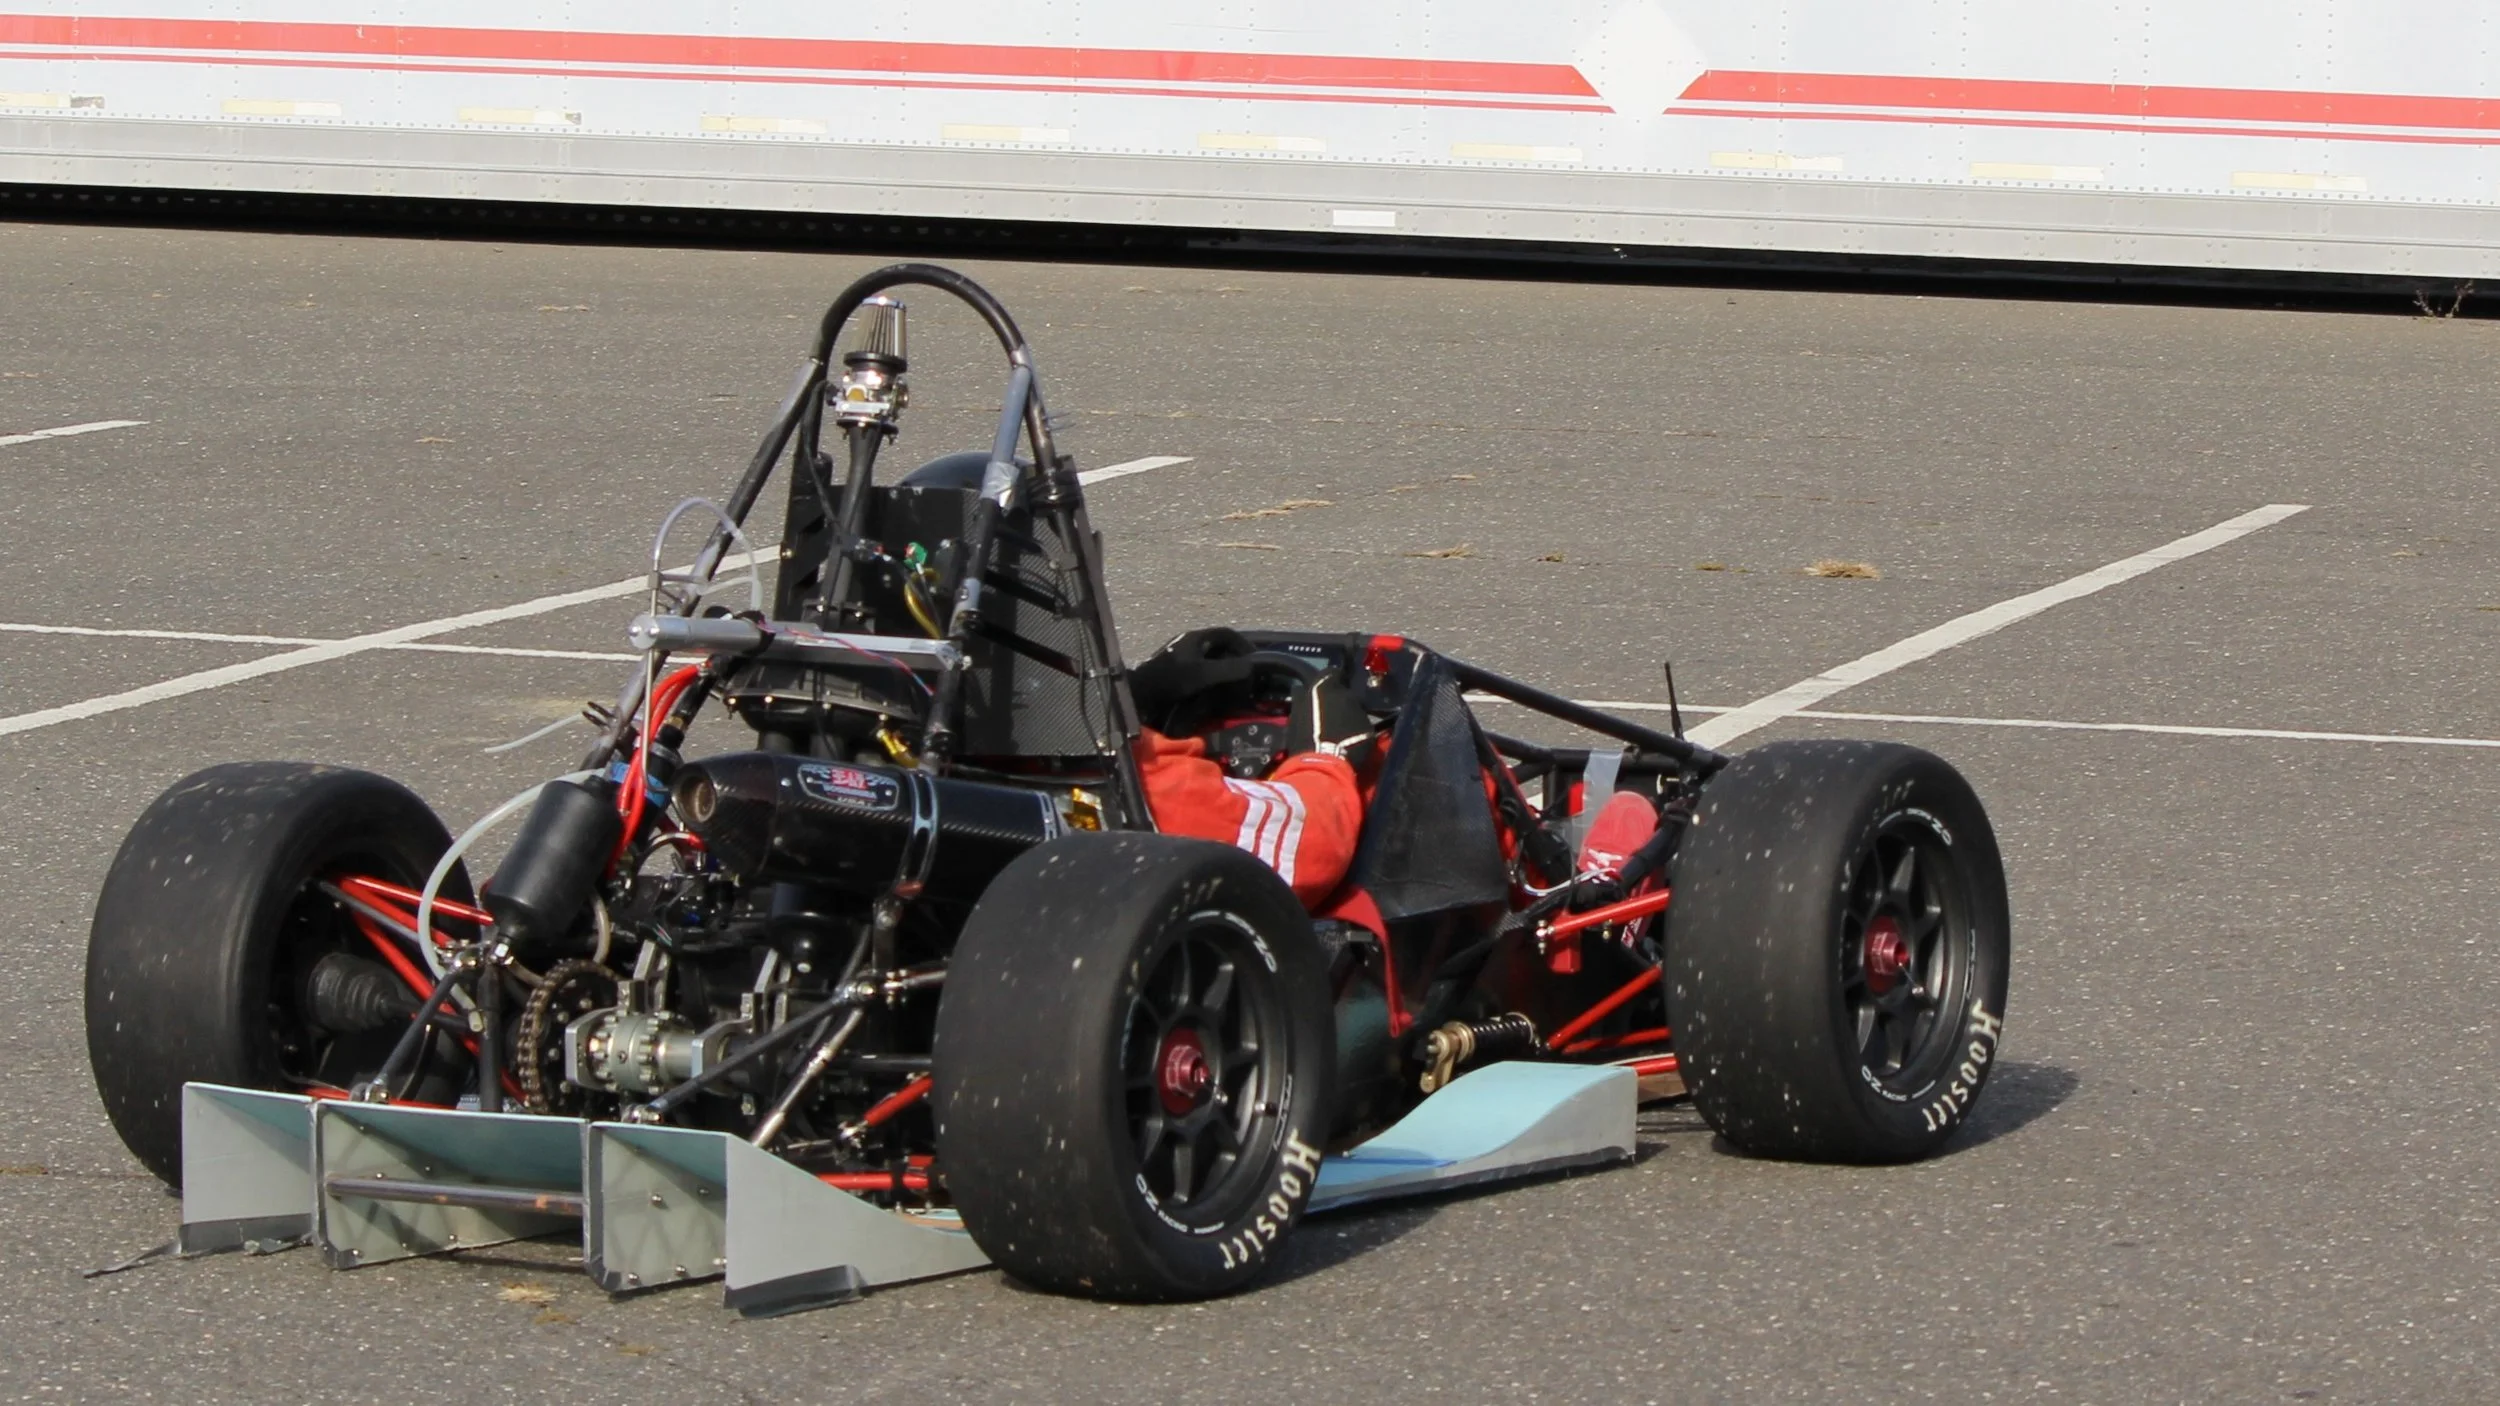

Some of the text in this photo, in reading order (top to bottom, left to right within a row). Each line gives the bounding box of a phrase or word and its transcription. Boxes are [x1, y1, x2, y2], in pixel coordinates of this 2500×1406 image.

[1861, 1065, 1883, 1093] OZ
[1921, 998, 2001, 1132] Hoosier
[1135, 1173, 1159, 1213] OZ
[1219, 1127, 1321, 1270] Hoosier
